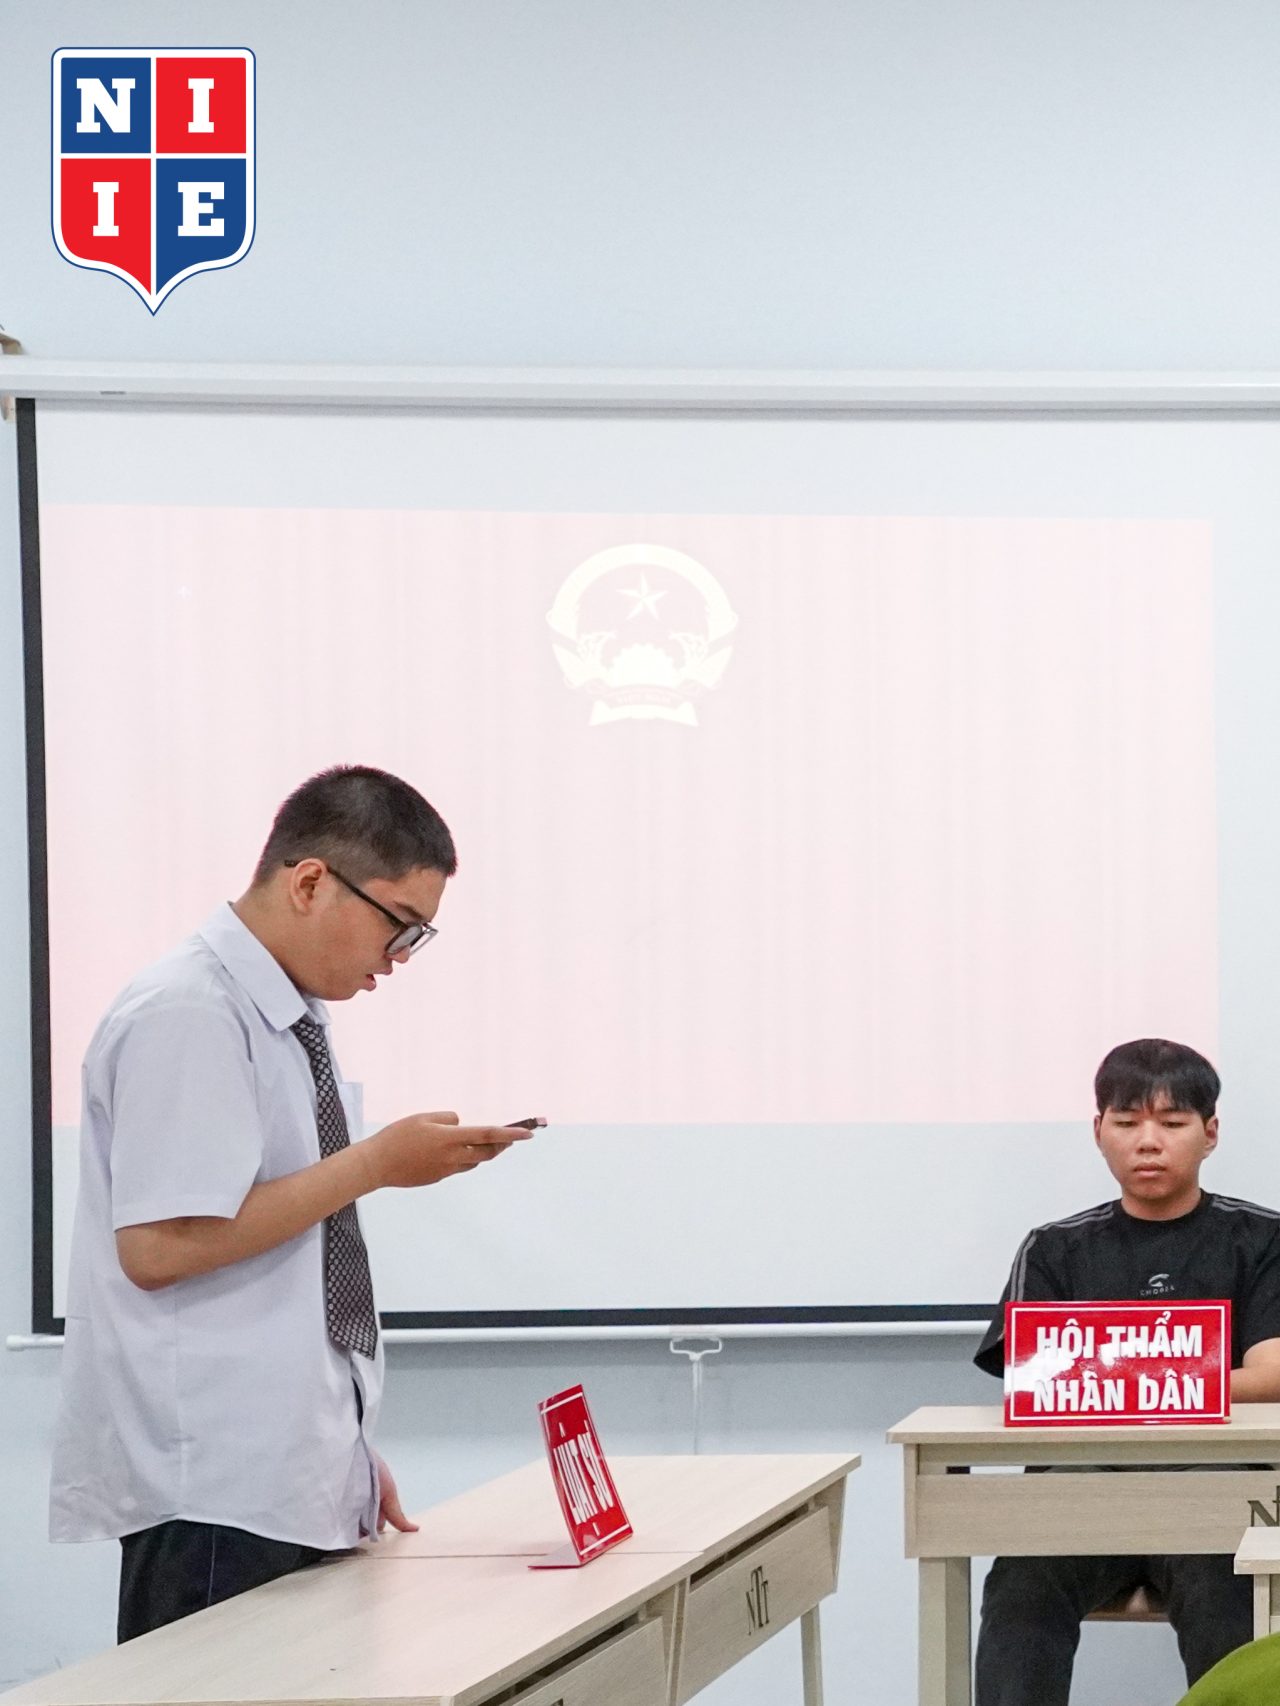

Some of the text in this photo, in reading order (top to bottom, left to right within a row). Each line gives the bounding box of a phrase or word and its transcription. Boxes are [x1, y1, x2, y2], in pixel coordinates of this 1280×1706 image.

[1106, 1311, 1203, 1358] THẨM
[1033, 1369, 1205, 1412] NHÂN DÂN
